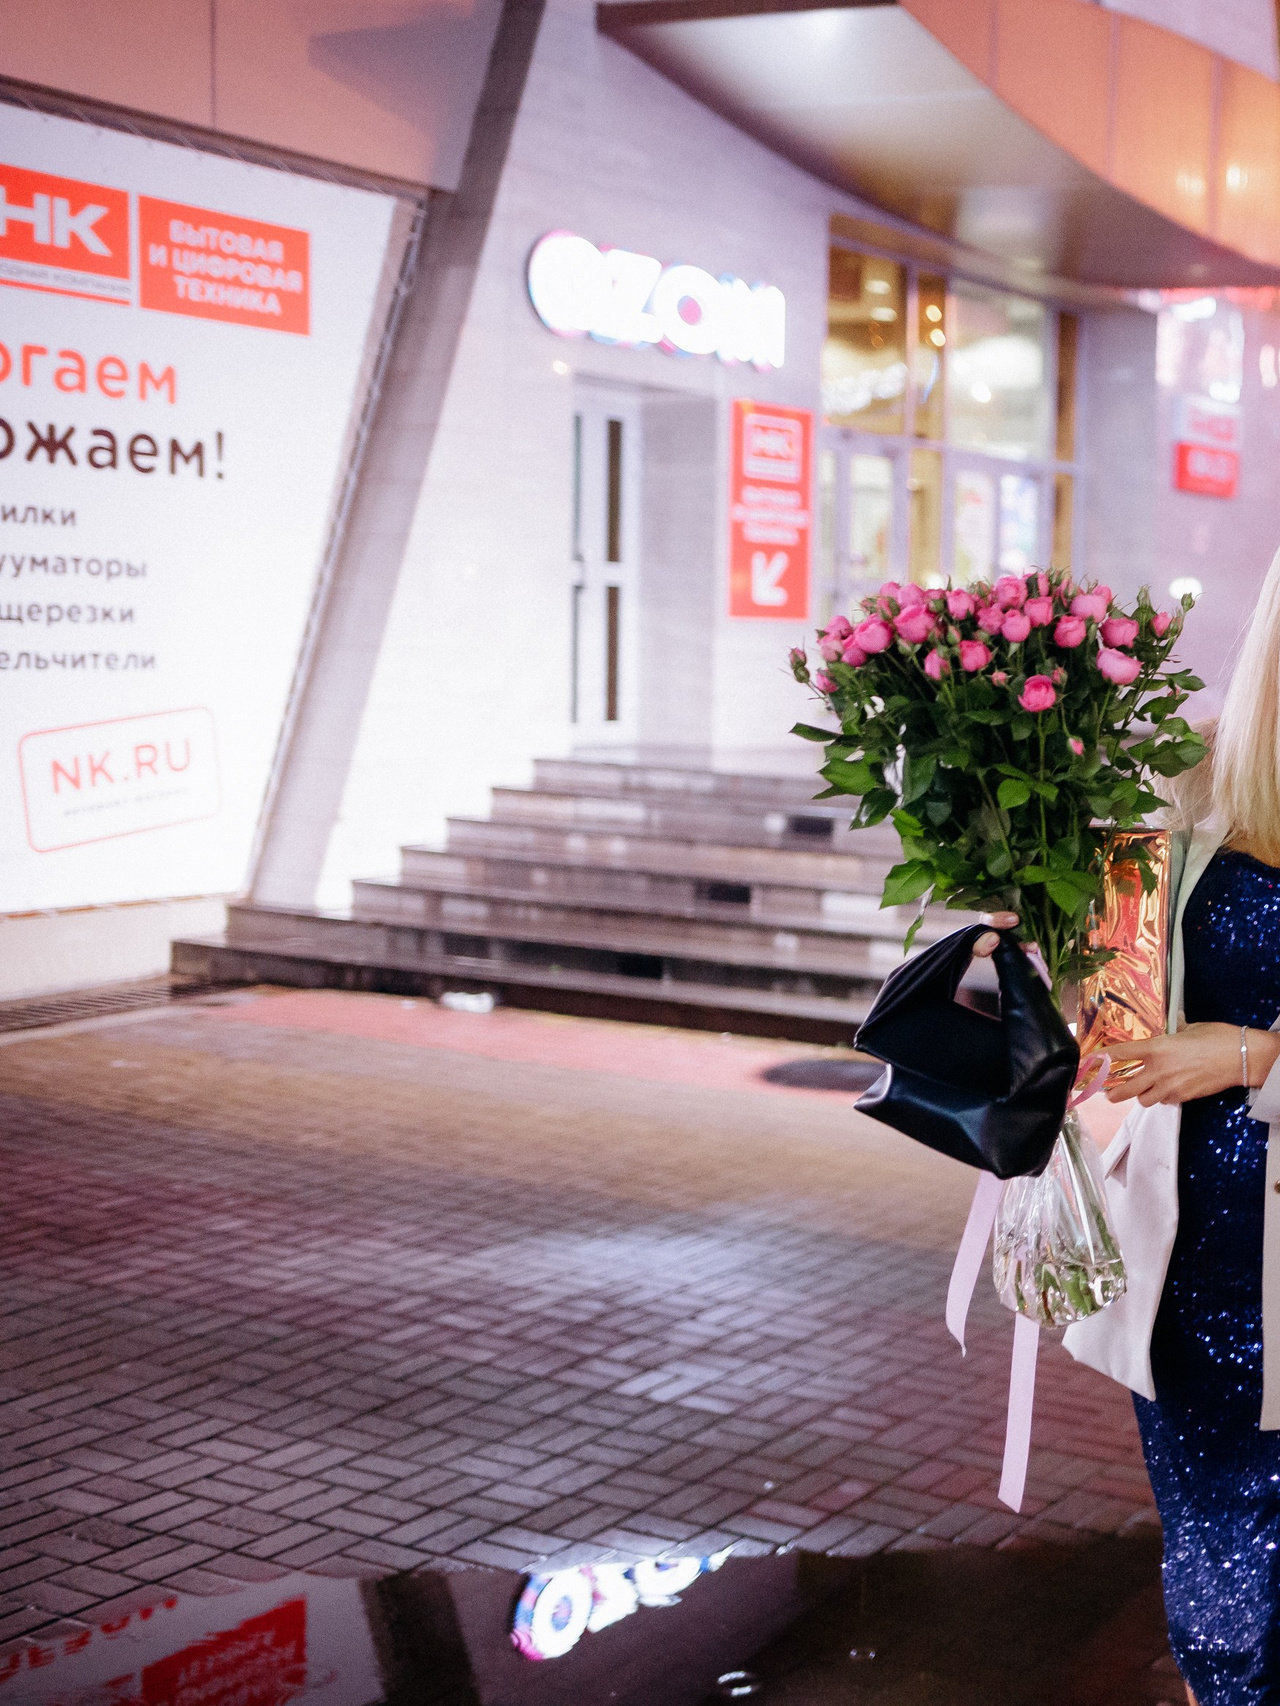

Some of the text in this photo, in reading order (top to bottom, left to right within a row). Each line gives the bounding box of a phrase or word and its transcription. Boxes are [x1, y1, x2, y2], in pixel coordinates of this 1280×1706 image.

[169, 219, 284, 263] БЫТОВАЯ
[149, 243, 167, 267] И
[172, 248, 303, 293] ЦИФРОВАЯ
[173, 275, 283, 316] ТЕХНИКА
[0, 651, 155, 670] ельчители
[51, 738, 192, 795] NK.RU
